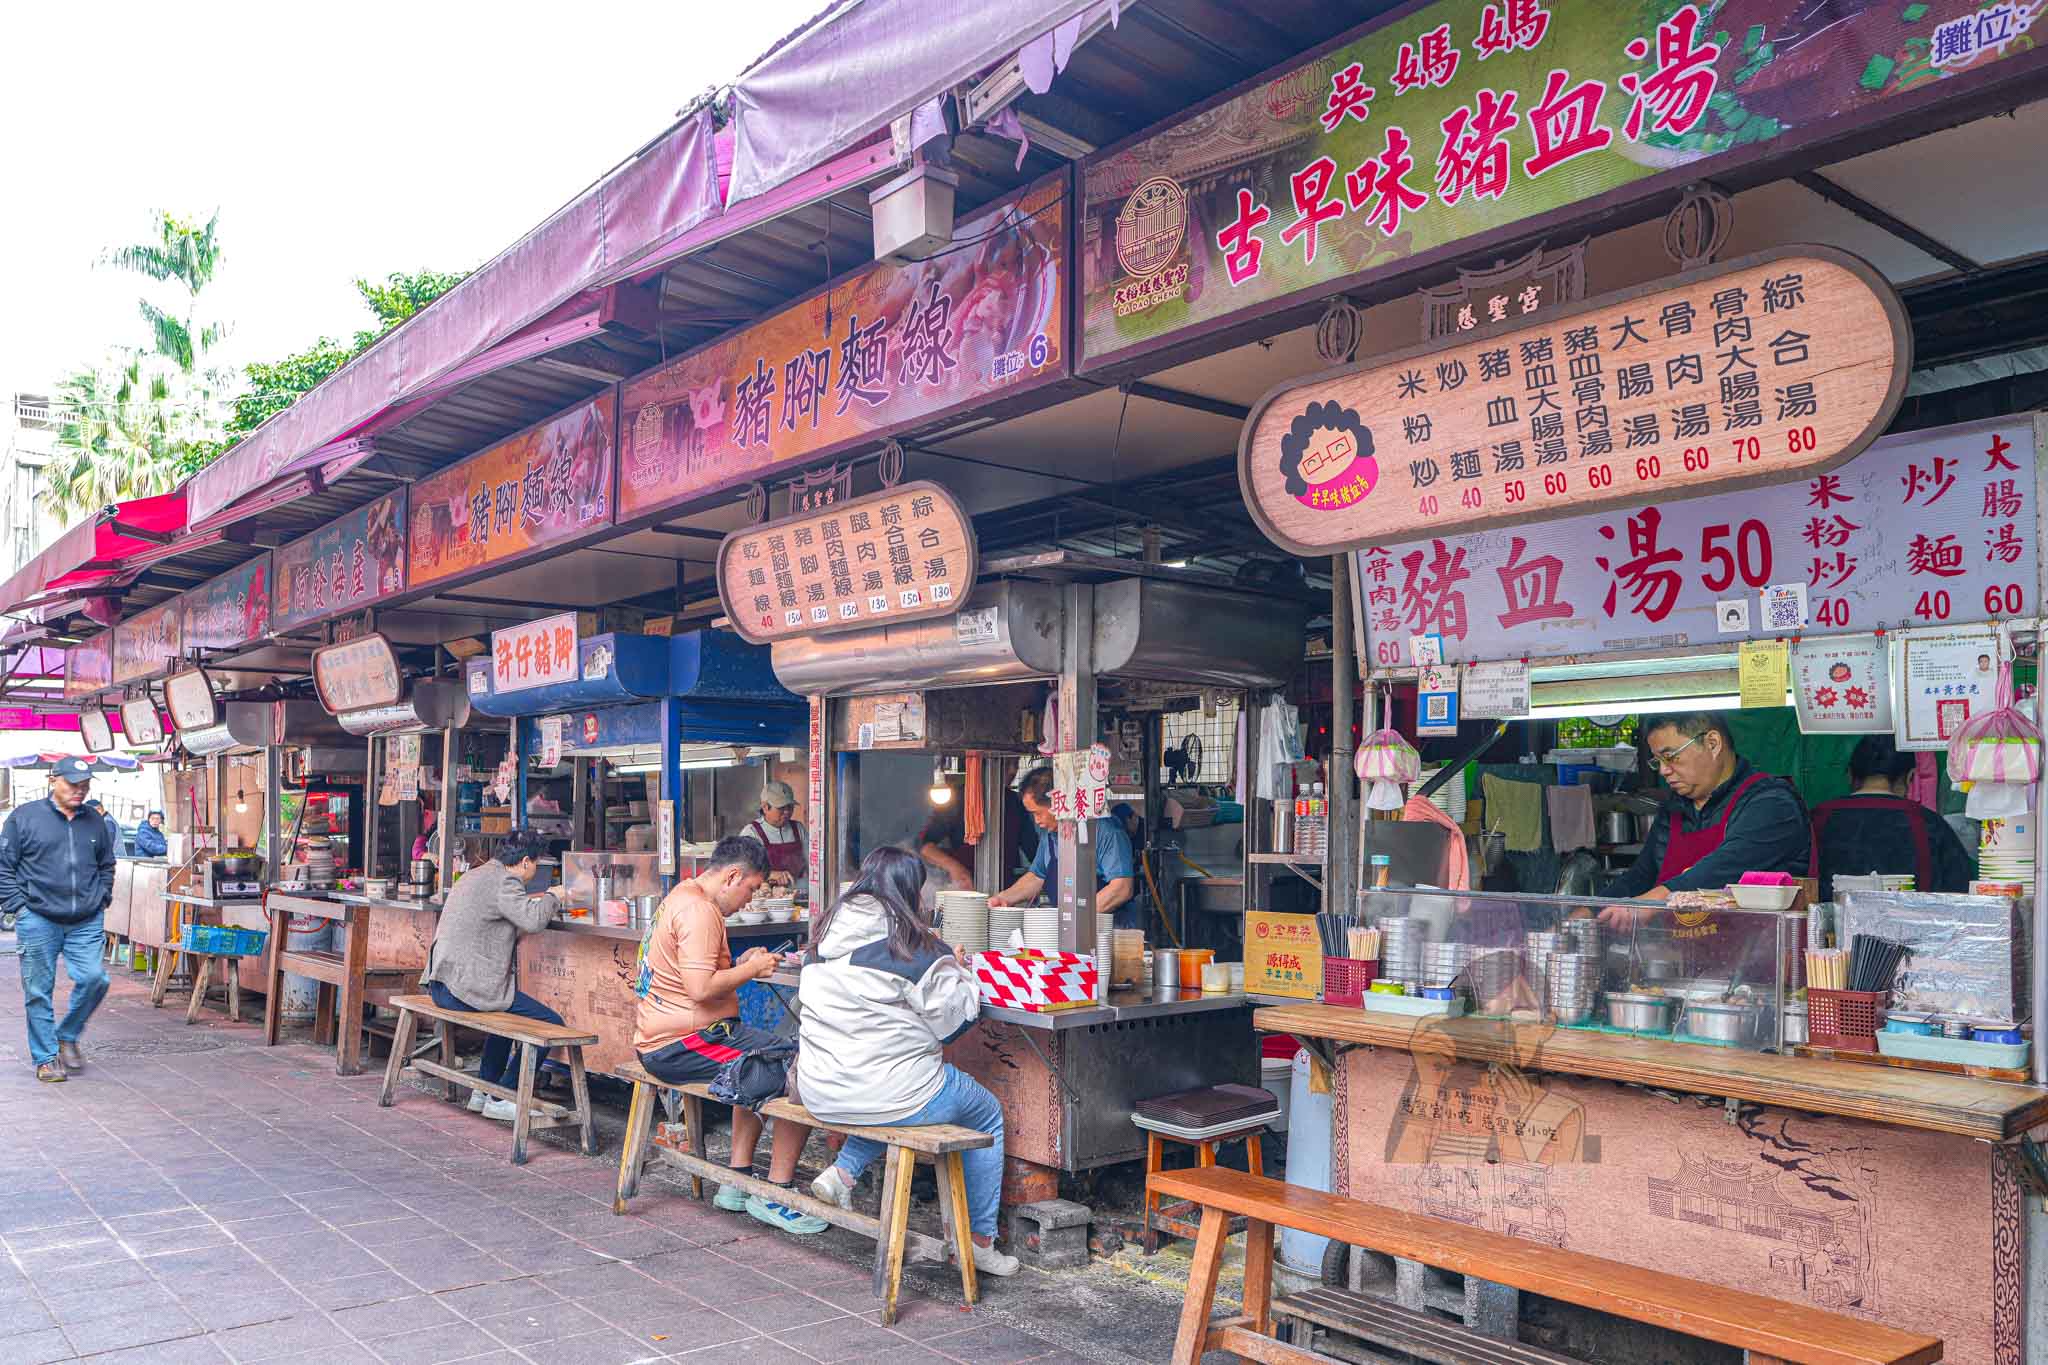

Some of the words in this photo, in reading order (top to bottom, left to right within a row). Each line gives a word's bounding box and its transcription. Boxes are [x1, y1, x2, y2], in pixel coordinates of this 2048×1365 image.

[1319, 0, 1549, 133] 吳媽媽
[1216, 4, 1722, 286] 古早味豬血湯
[1132, 297, 1150, 312] DAO
[1151, 286, 1181, 305] CHENG
[1455, 285, 1544, 331] 慈聖宮
[733, 282, 957, 447] 豬腳麵線
[1030, 333, 1047, 366] 6
[1658, 301, 1712, 440] 骨肉湯
[1709, 287, 1764, 431] 骨肉大腸湯
[1761, 273, 1818, 419] 綜合湯
[1479, 347, 1525, 474] 豬血湯
[1520, 337, 1569, 467] 豬血大腸湯
[1564, 325, 1614, 459] 豬血骨肉湯
[1609, 315, 1661, 449] 大腸湯
[1398, 372, 1440, 489] 米粉炒
[1436, 358, 1482, 482] 炒麵
[1733, 435, 1762, 464] 70
[1788, 426, 1818, 454] 80
[1544, 472, 1568, 497] 60
[1588, 463, 1613, 488] 60
[1636, 456, 1662, 481] 60
[1683, 446, 1710, 472] 60
[469, 450, 575, 545] 豬腳麵線
[597, 494, 604, 515] 6
[1418, 495, 1440, 517] 40
[1461, 487, 1482, 508] 40
[1504, 480, 1526, 504] 50
[1900, 457, 1967, 576] 炒麵
[1981, 435, 2023, 565] 大腸湯
[820, 519, 855, 597] 腿肉麵線
[849, 511, 884, 592] 腿肉湯
[880, 503, 915, 586] 綜合麵線
[911, 496, 947, 580] 綜合湯
[1806, 475, 1861, 590] 米粉炒
[743, 541, 773, 613] 乾麵線
[767, 535, 798, 608] 豬腳麵線
[793, 527, 825, 603] 豬腳湯
[934, 585, 950, 598] 130
[1401, 507, 1684, 641] 豬血湯
[1700, 519, 1773, 592] 50
[761, 615, 773, 628] 40
[787, 613, 801, 624] 150
[813, 607, 826, 620] 130
[842, 606, 856, 617] 150
[872, 600, 886, 611] 130
[902, 593, 918, 605] 150
[1816, 598, 1850, 628] 40
[1915, 590, 1951, 621] 40
[1983, 584, 2023, 615] 60
[1378, 641, 1400, 665] 60
